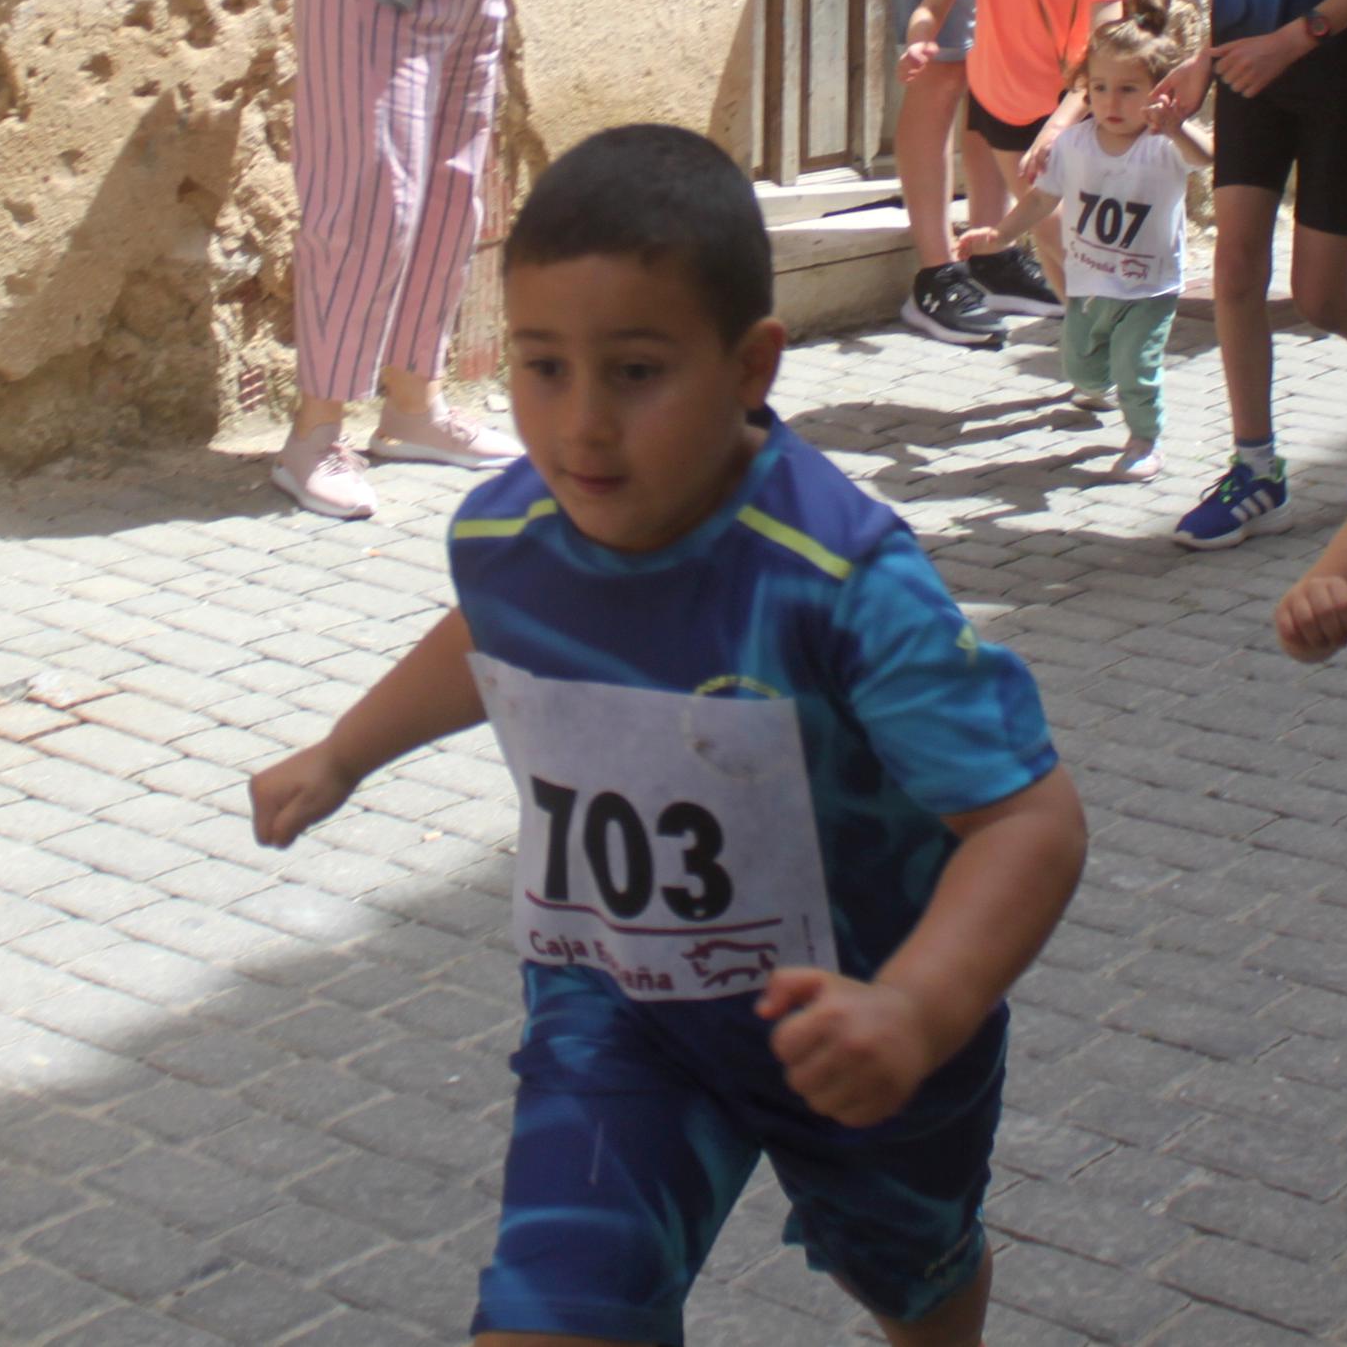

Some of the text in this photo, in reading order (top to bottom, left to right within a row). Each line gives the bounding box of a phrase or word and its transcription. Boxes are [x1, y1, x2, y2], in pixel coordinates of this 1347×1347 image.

[1075, 191, 1151, 250] 707
[530, 774, 734, 921] 703
[530, 930, 588, 963] Caja
